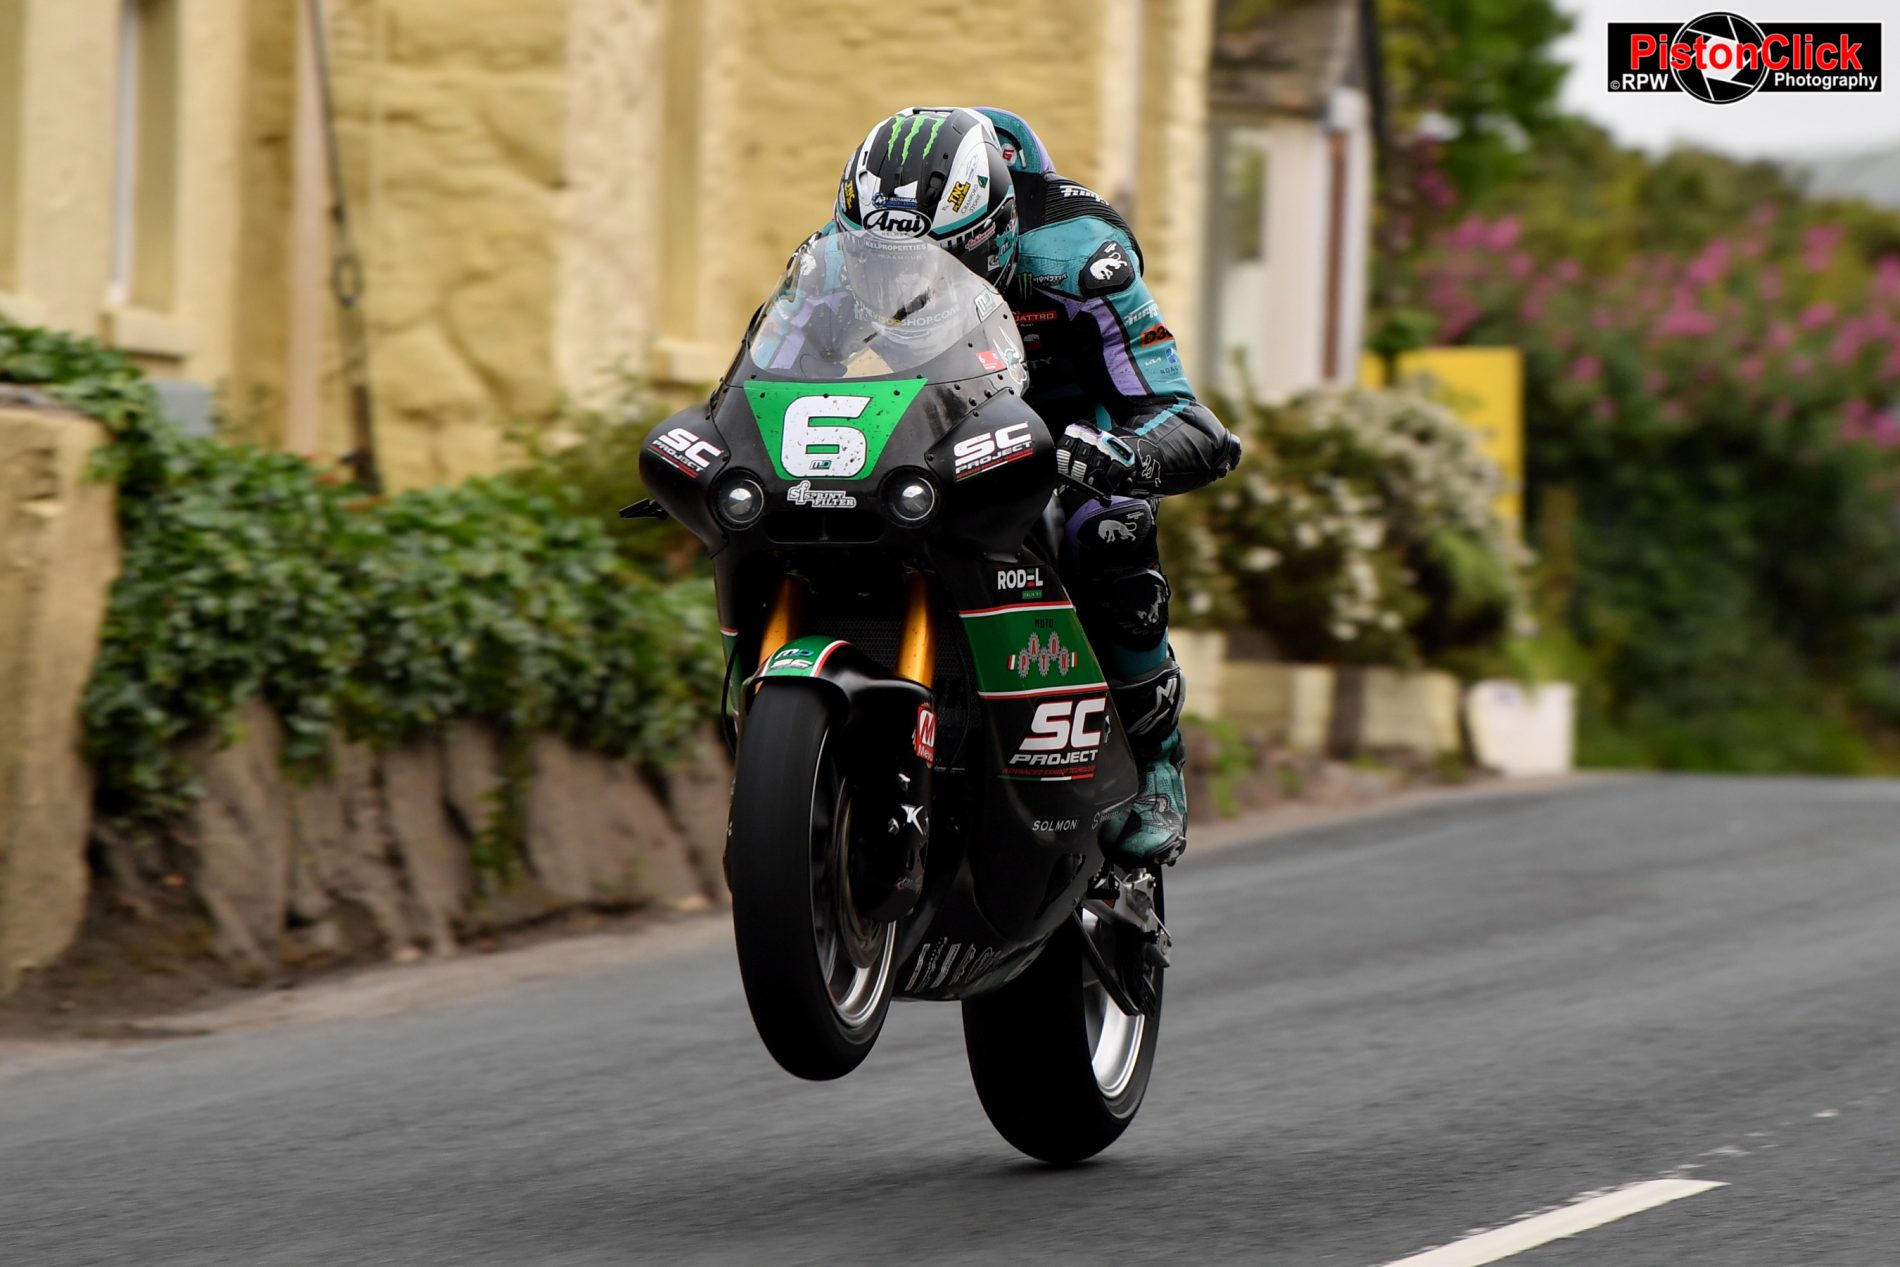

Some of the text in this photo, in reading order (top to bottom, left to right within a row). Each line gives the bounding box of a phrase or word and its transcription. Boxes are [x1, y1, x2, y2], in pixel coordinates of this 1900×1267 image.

[948, 182, 964, 204] TNC
[866, 211, 922, 232] Arai
[657, 428, 722, 468] SC
[781, 395, 874, 478] 6
[953, 422, 1032, 467] SC
[652, 439, 704, 472] PROJECT
[955, 440, 1033, 474] PROJECT
[804, 492, 844, 500] SPRINT
[813, 498, 854, 507] FILTER
[1018, 697, 1106, 751] SC
[1008, 749, 1098, 765] PROJECT
[1031, 819, 1077, 832] SOLMON
